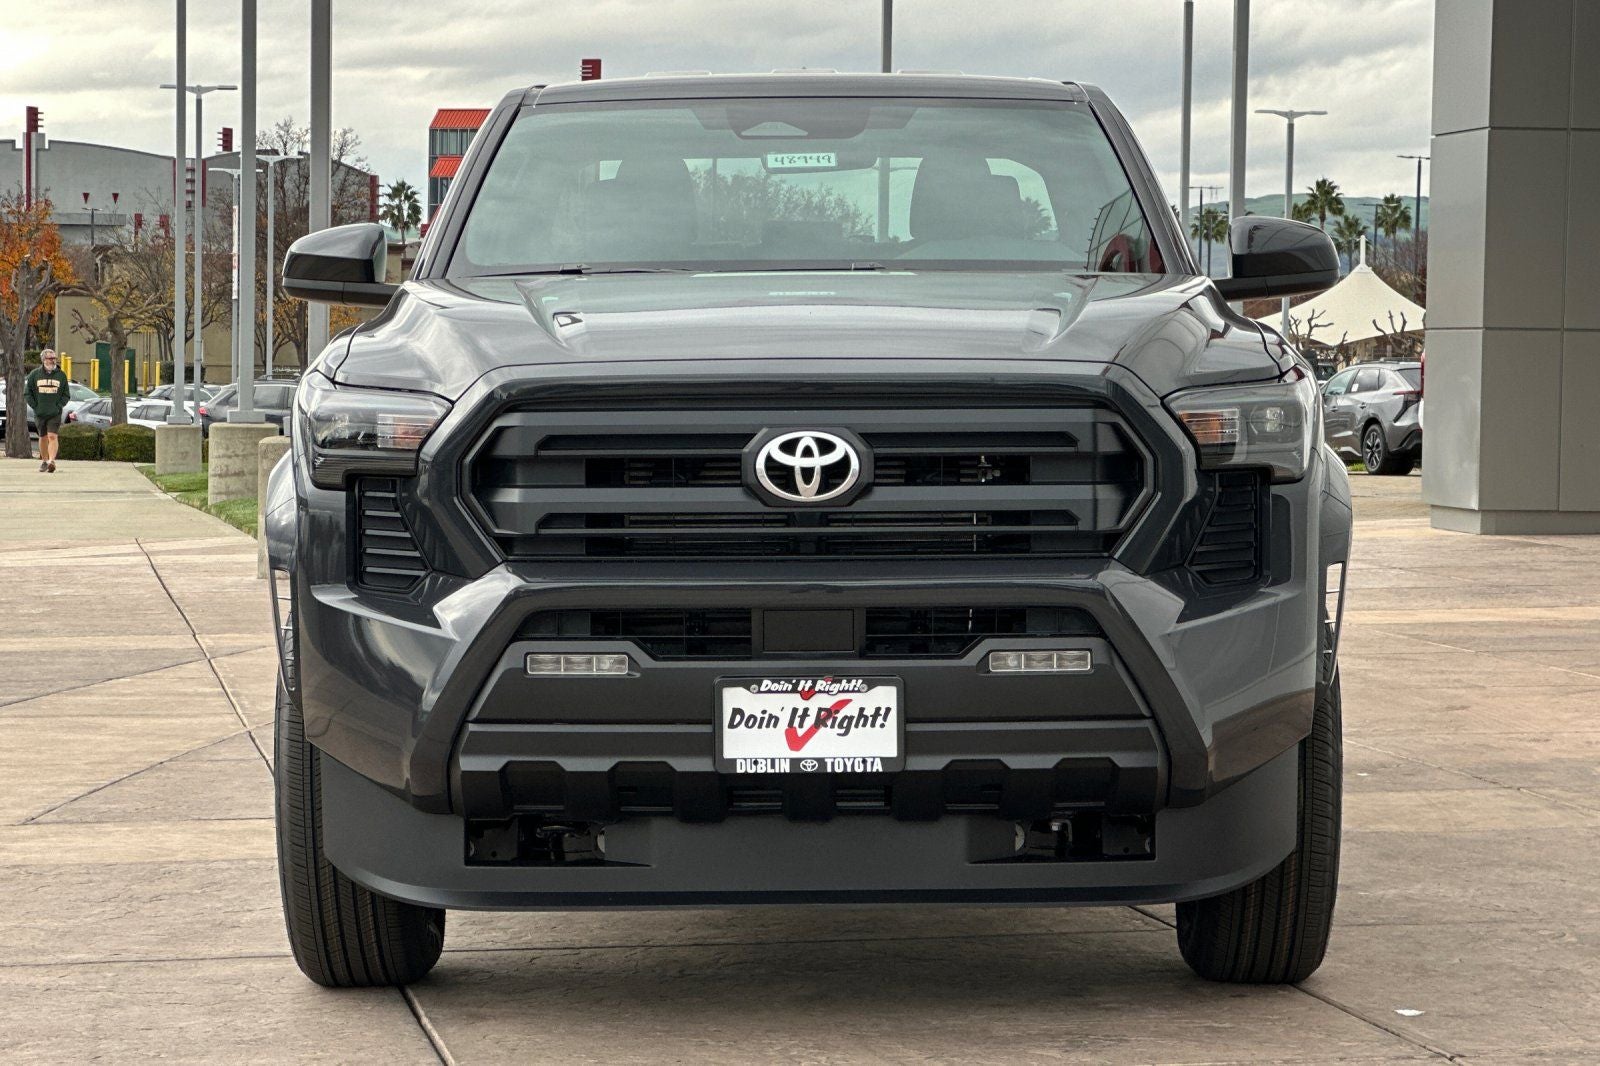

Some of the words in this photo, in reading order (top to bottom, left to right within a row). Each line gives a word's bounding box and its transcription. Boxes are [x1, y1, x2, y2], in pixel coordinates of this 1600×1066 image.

[760, 679, 796, 692] Doin'
[798, 680, 812, 691] It
[814, 679, 863, 695] Right!
[727, 706, 785, 730] Doin'
[787, 706, 811, 729] It
[813, 706, 892, 737] Right!
[736, 758, 791, 773] DUBLIN
[824, 757, 883, 773] TOYOTA
